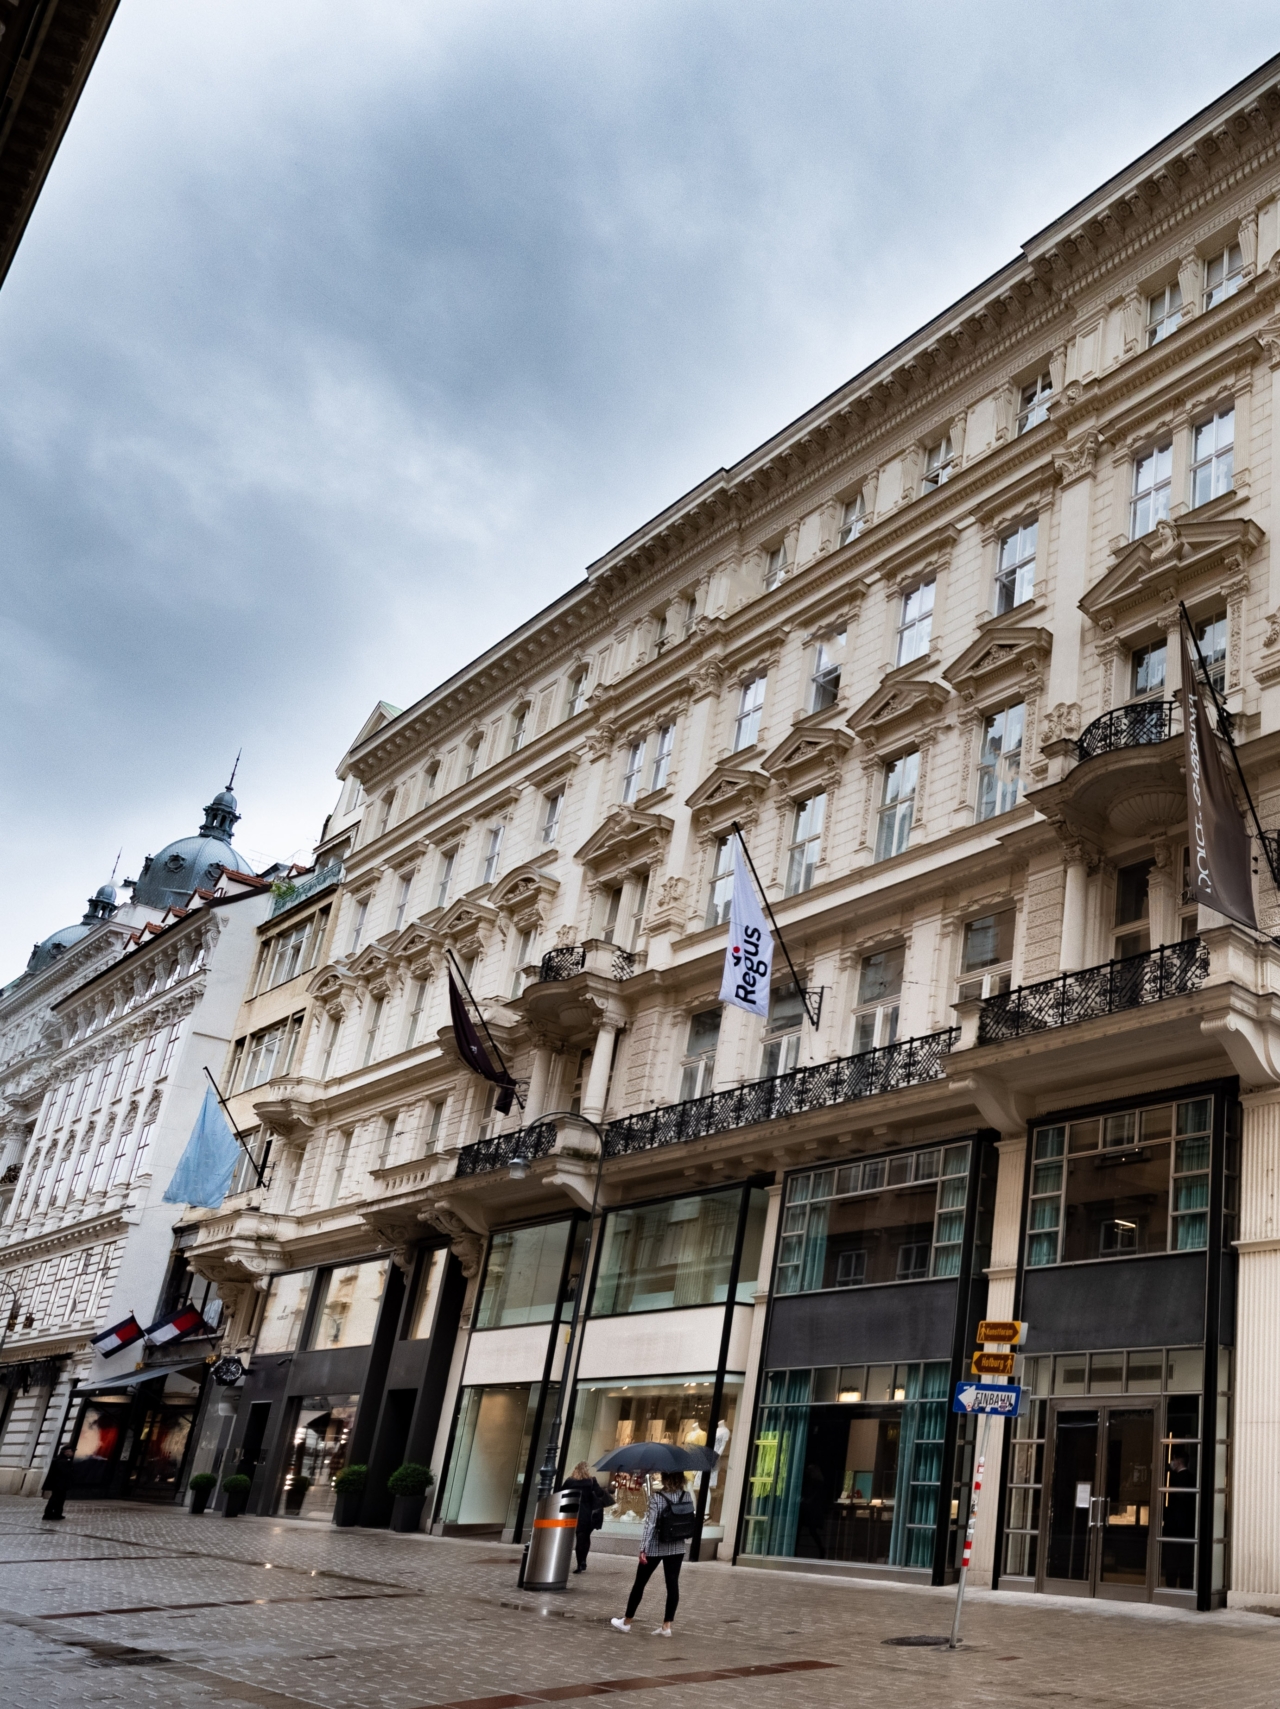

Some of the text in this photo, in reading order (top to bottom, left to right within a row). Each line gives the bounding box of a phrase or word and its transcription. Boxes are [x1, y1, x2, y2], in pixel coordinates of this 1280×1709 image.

[735, 925, 768, 1005] Regus
[985, 1327, 1013, 1336] Kunstforum
[981, 1357, 1004, 1369] Hofburg
[975, 1391, 1013, 1407] EINBAHN
[614, 1473, 642, 1491] SALE
